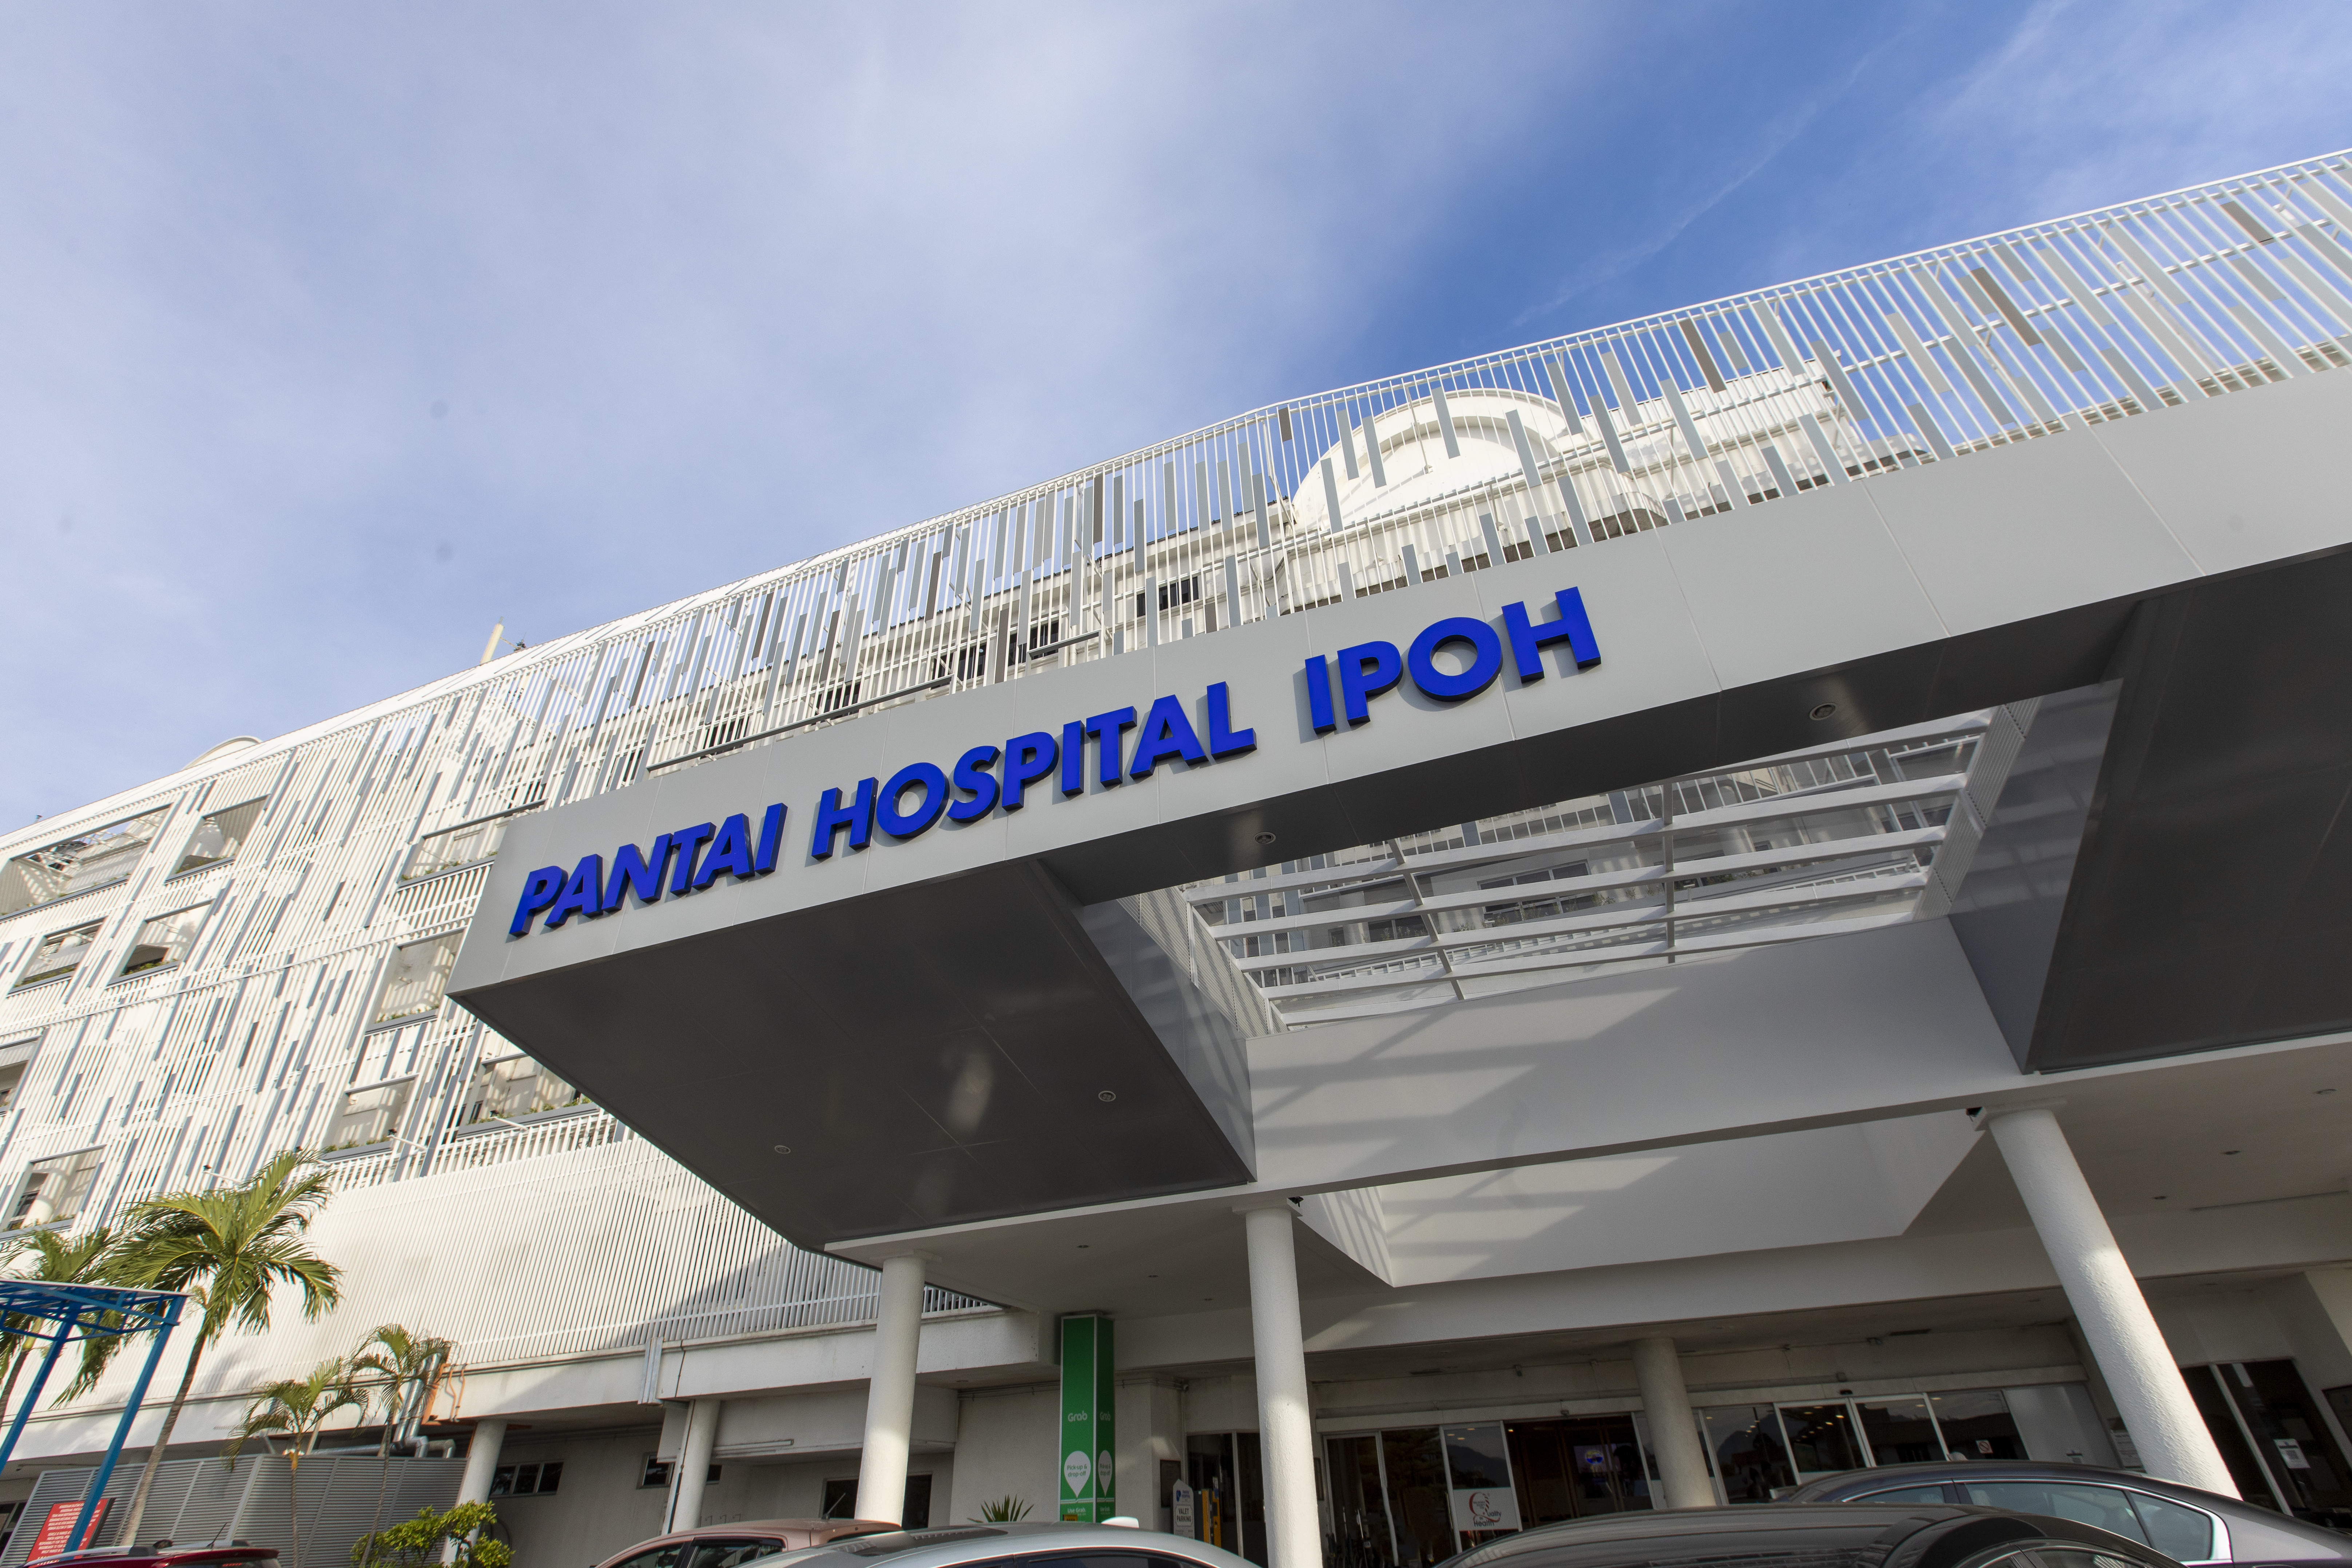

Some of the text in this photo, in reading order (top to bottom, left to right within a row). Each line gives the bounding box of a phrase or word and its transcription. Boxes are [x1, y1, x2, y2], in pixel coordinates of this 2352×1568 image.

[508, 586, 1601, 937] PANTAI HOSPITAL IPOH
[1068, 1410, 1088, 1422] Grab
[1100, 1411, 1111, 1421] Grab
